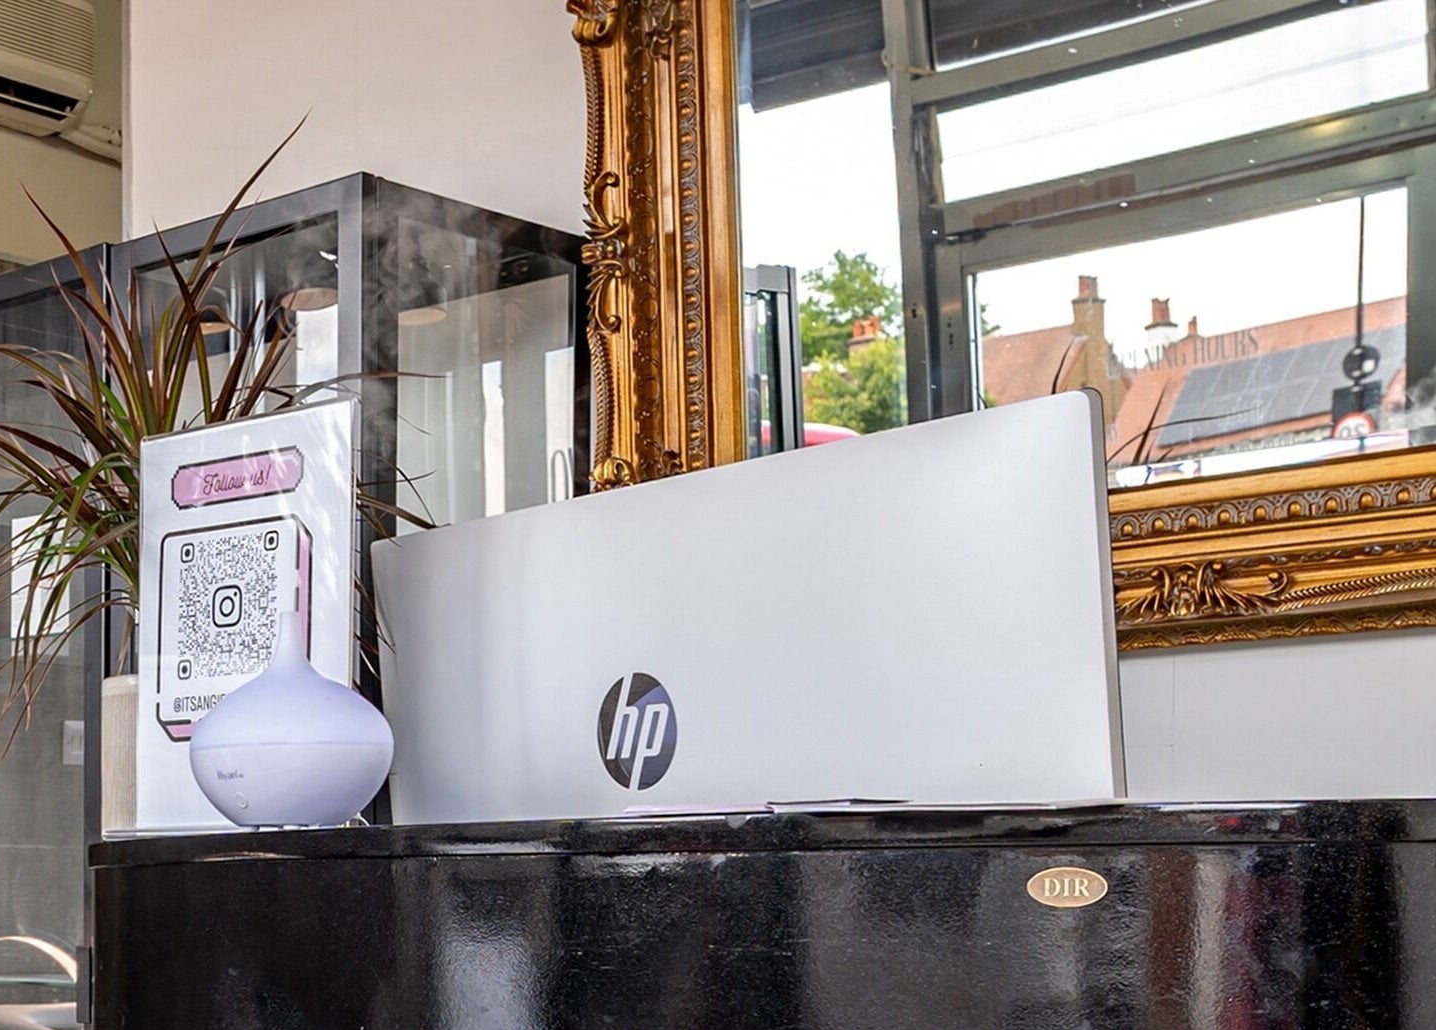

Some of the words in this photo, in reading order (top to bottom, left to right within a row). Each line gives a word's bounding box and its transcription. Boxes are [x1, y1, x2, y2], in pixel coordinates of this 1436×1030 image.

[1193, 329, 1259, 365] HOURS
[203, 473, 246, 496] Follow
[249, 463, 272, 486] us!
[173, 693, 230, 713] @ITSANGI
[605, 672, 670, 791] hp
[1043, 877, 1091, 898] DIR
